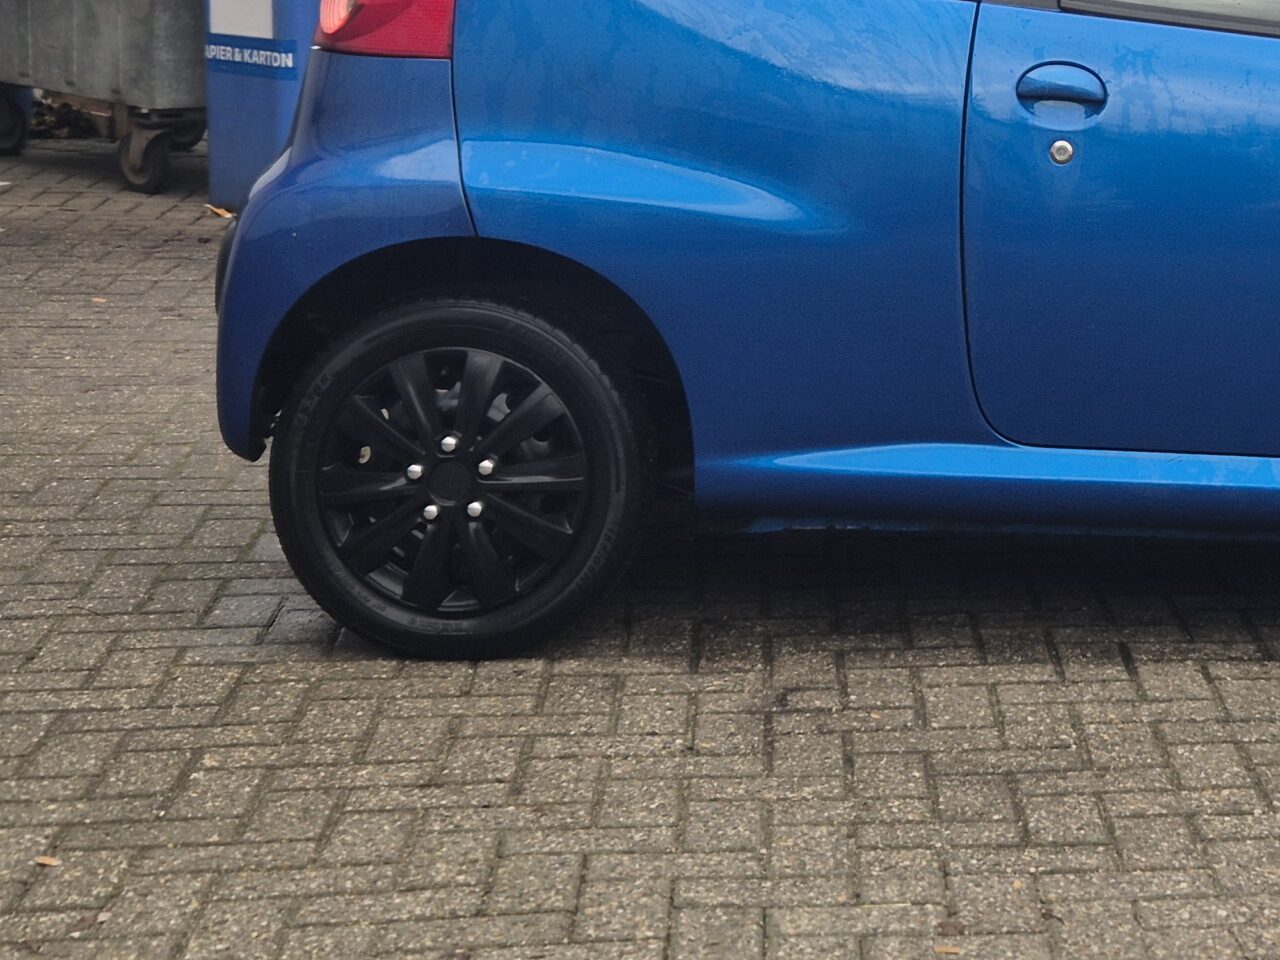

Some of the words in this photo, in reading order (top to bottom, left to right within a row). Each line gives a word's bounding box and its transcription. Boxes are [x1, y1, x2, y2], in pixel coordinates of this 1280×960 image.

[205, 44, 233, 61] APIER
[234, 47, 242, 62] &
[243, 48, 294, 68] KARTON
